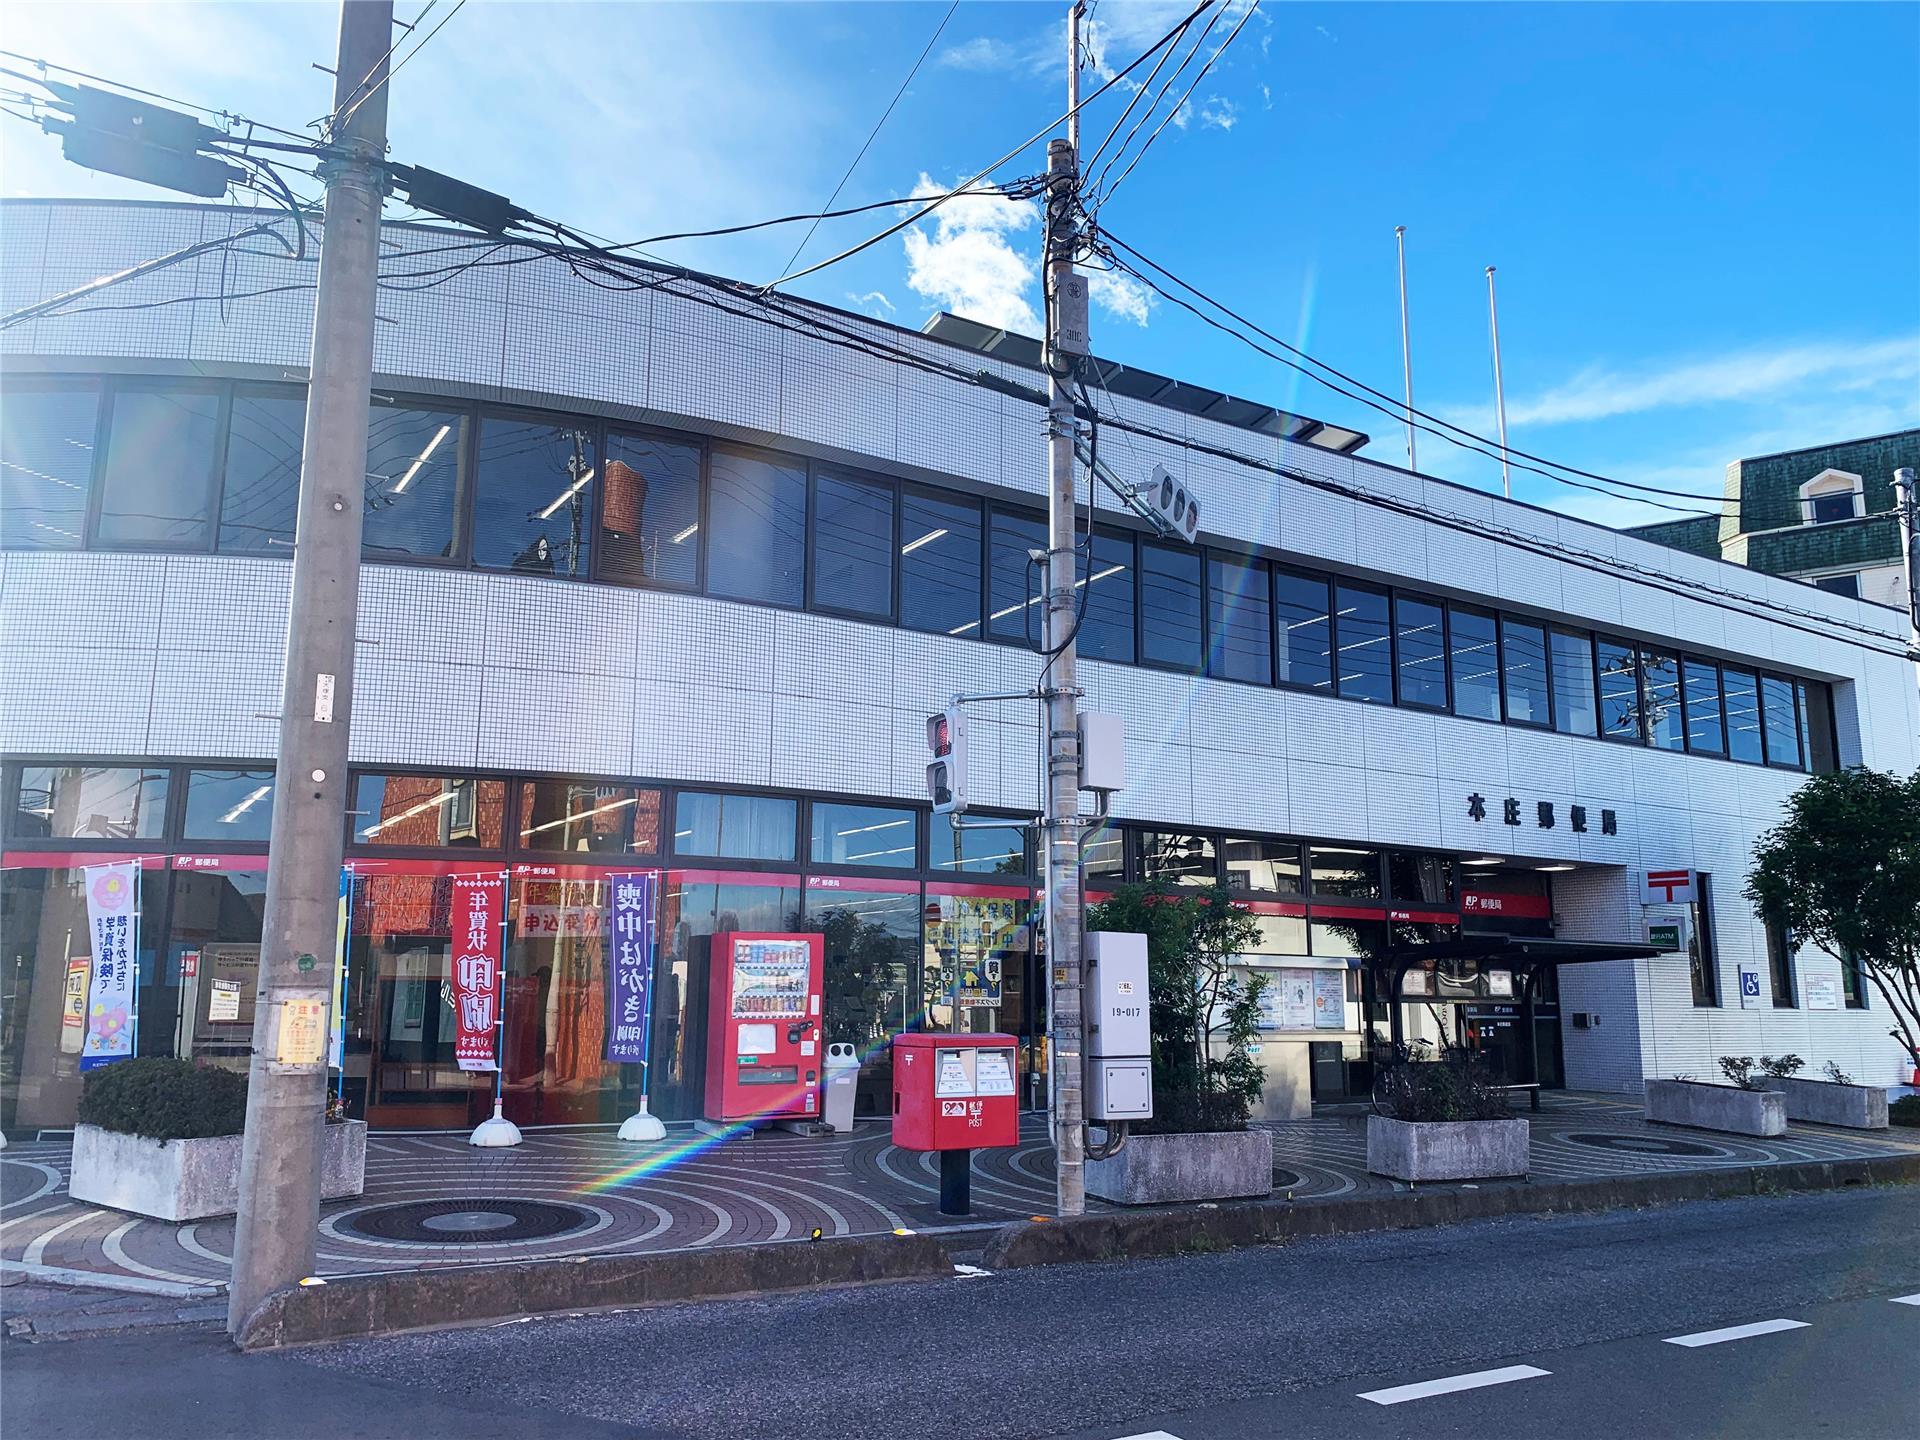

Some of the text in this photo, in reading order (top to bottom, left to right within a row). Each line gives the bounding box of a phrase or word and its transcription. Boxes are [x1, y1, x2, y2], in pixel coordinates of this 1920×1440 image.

[1467, 792, 1617, 836] 本庄郵便局
[195, 858, 219, 866] 郵便局
[1480, 898, 1502, 910] 郵便局
[1112, 1007, 1140, 1017] 19-017
[968, 1119, 983, 1128] POST
